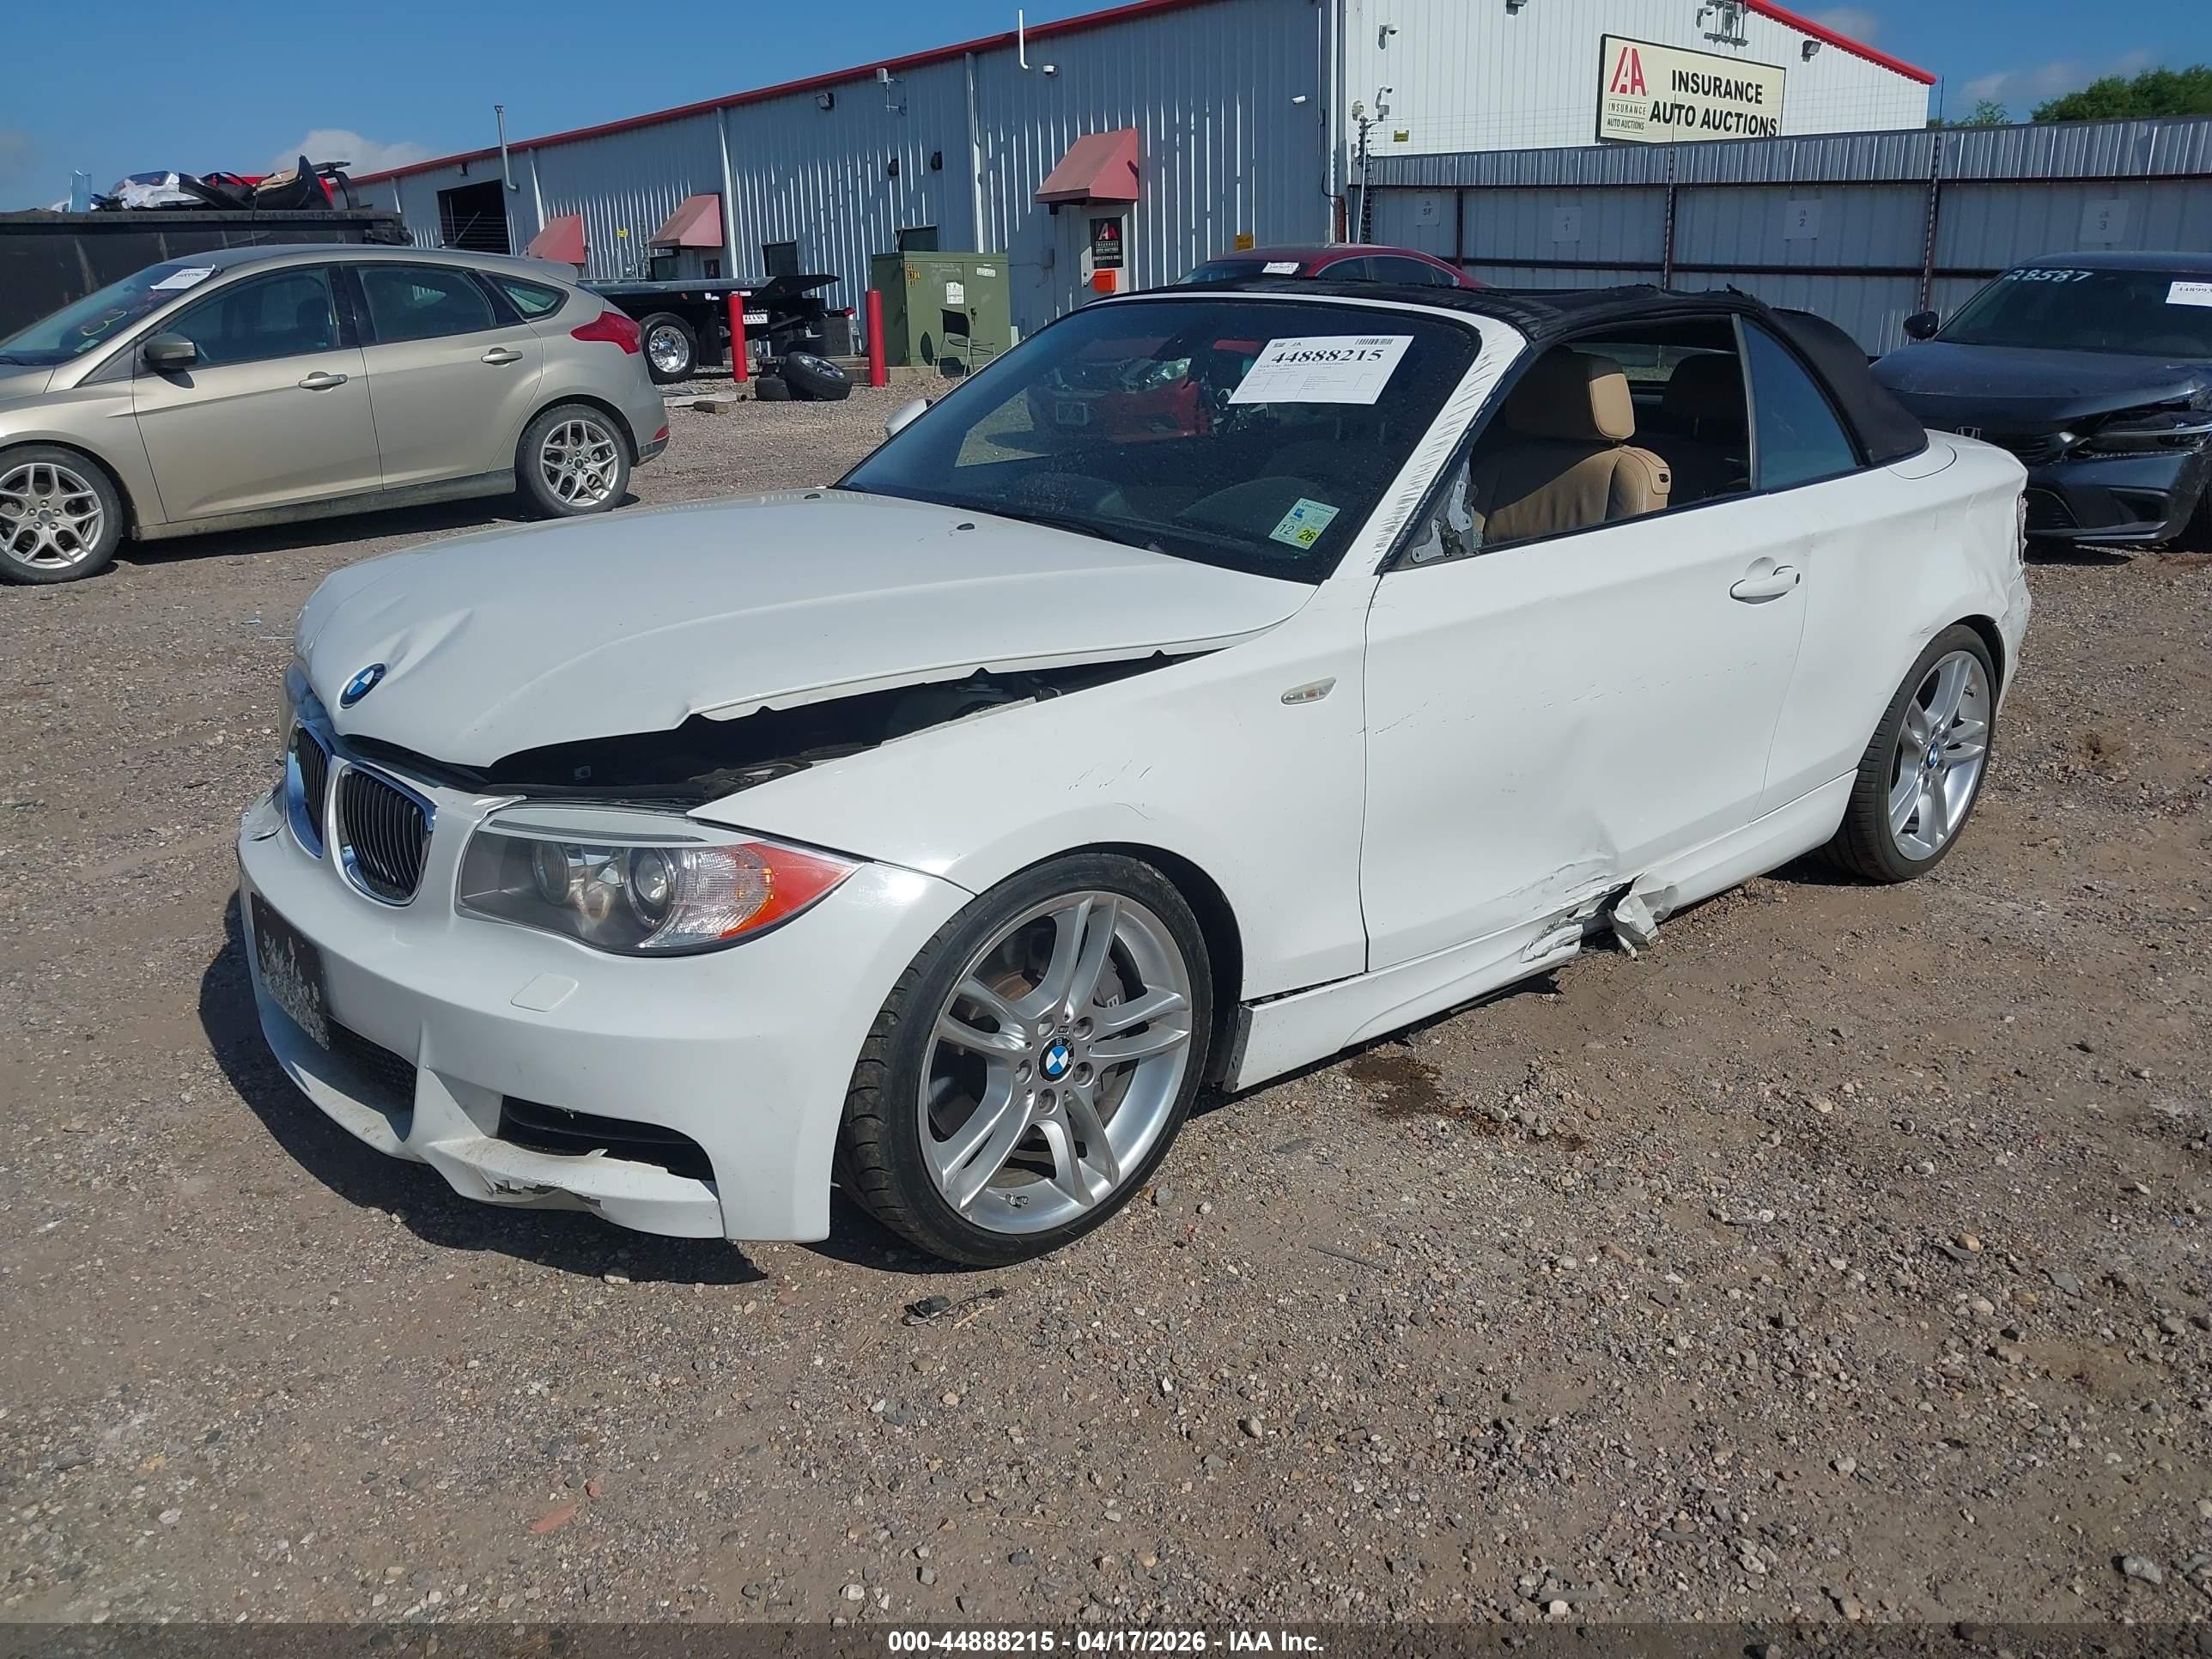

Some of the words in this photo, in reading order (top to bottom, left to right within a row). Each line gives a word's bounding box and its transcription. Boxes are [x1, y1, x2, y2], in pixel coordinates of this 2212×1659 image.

[1672, 69, 1764, 105] INSURANCE
[1607, 102, 1647, 116] INSURANCE
[1607, 118, 1621, 128] AUTO
[1621, 119, 1645, 131] AUCTIONS
[1649, 100, 1697, 128] AUTO
[1700, 107, 1778, 137] AUCTIONS
[1271, 349, 1385, 363] 44888215
[1279, 524, 1295, 535] 12
[1298, 529, 1316, 542] 26
